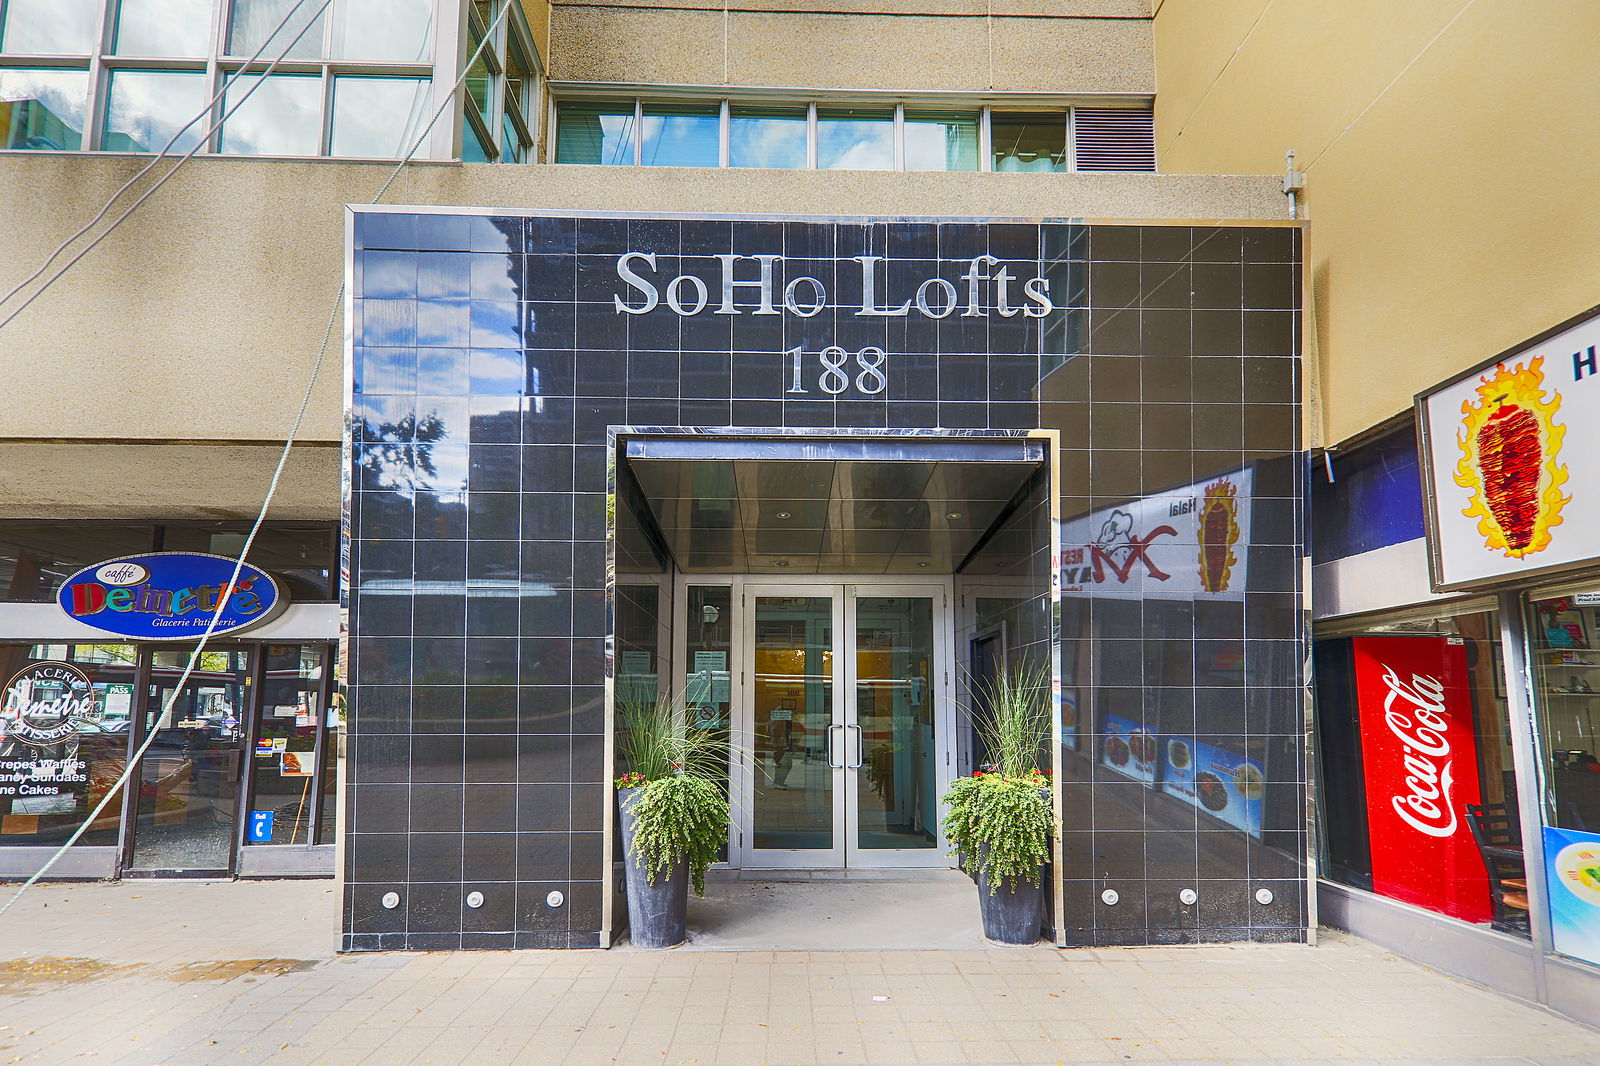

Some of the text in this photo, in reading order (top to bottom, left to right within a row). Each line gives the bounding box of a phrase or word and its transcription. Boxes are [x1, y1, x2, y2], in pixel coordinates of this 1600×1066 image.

[613, 251, 1053, 319] SoHo Lofts
[785, 345, 887, 395] 188
[104, 566, 137, 583] caffé
[151, 617, 237, 627] Glacerie Patiserie
[0, 759, 86, 772] repes Waffles
[31, 771, 87, 782] Sundaes
[19, 784, 59, 795] Cakes
